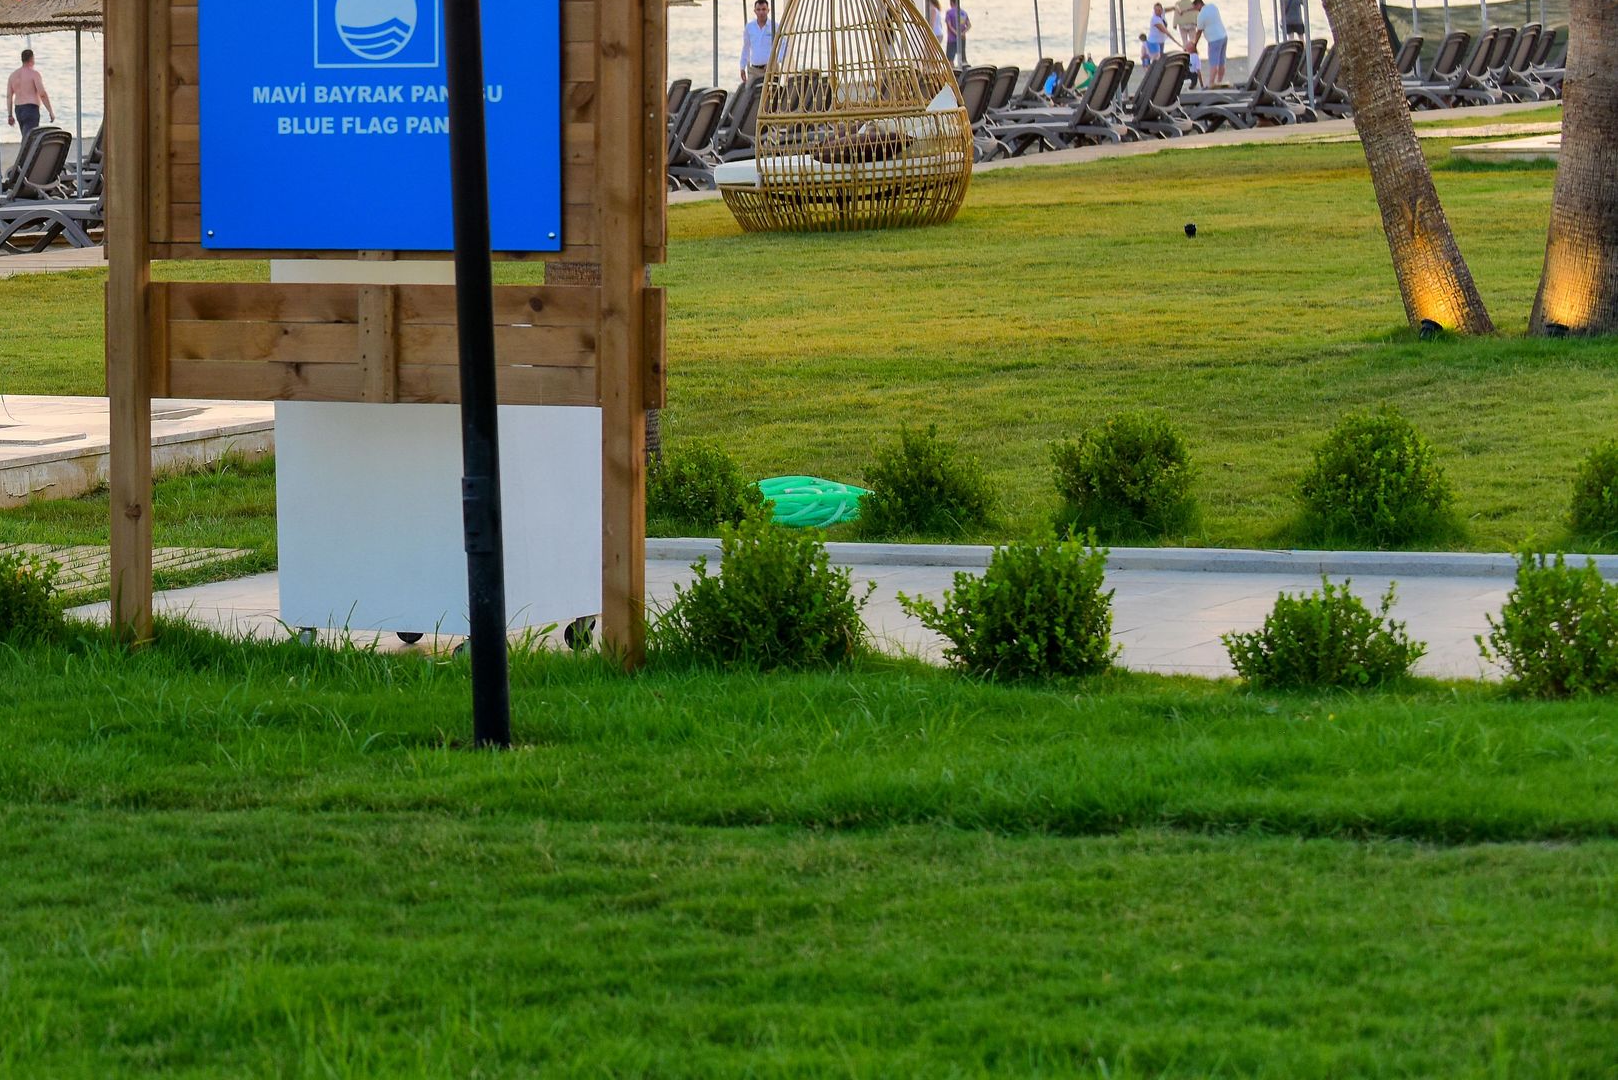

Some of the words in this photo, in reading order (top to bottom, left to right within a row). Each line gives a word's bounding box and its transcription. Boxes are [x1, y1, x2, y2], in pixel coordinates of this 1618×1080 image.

[253, 83, 306, 103] MAVİ
[314, 85, 404, 103] BAYRAK
[411, 85, 503, 103] PANU
[278, 117, 335, 134] BLUE
[342, 117, 399, 134] FLAG
[406, 116, 451, 134] PAN
